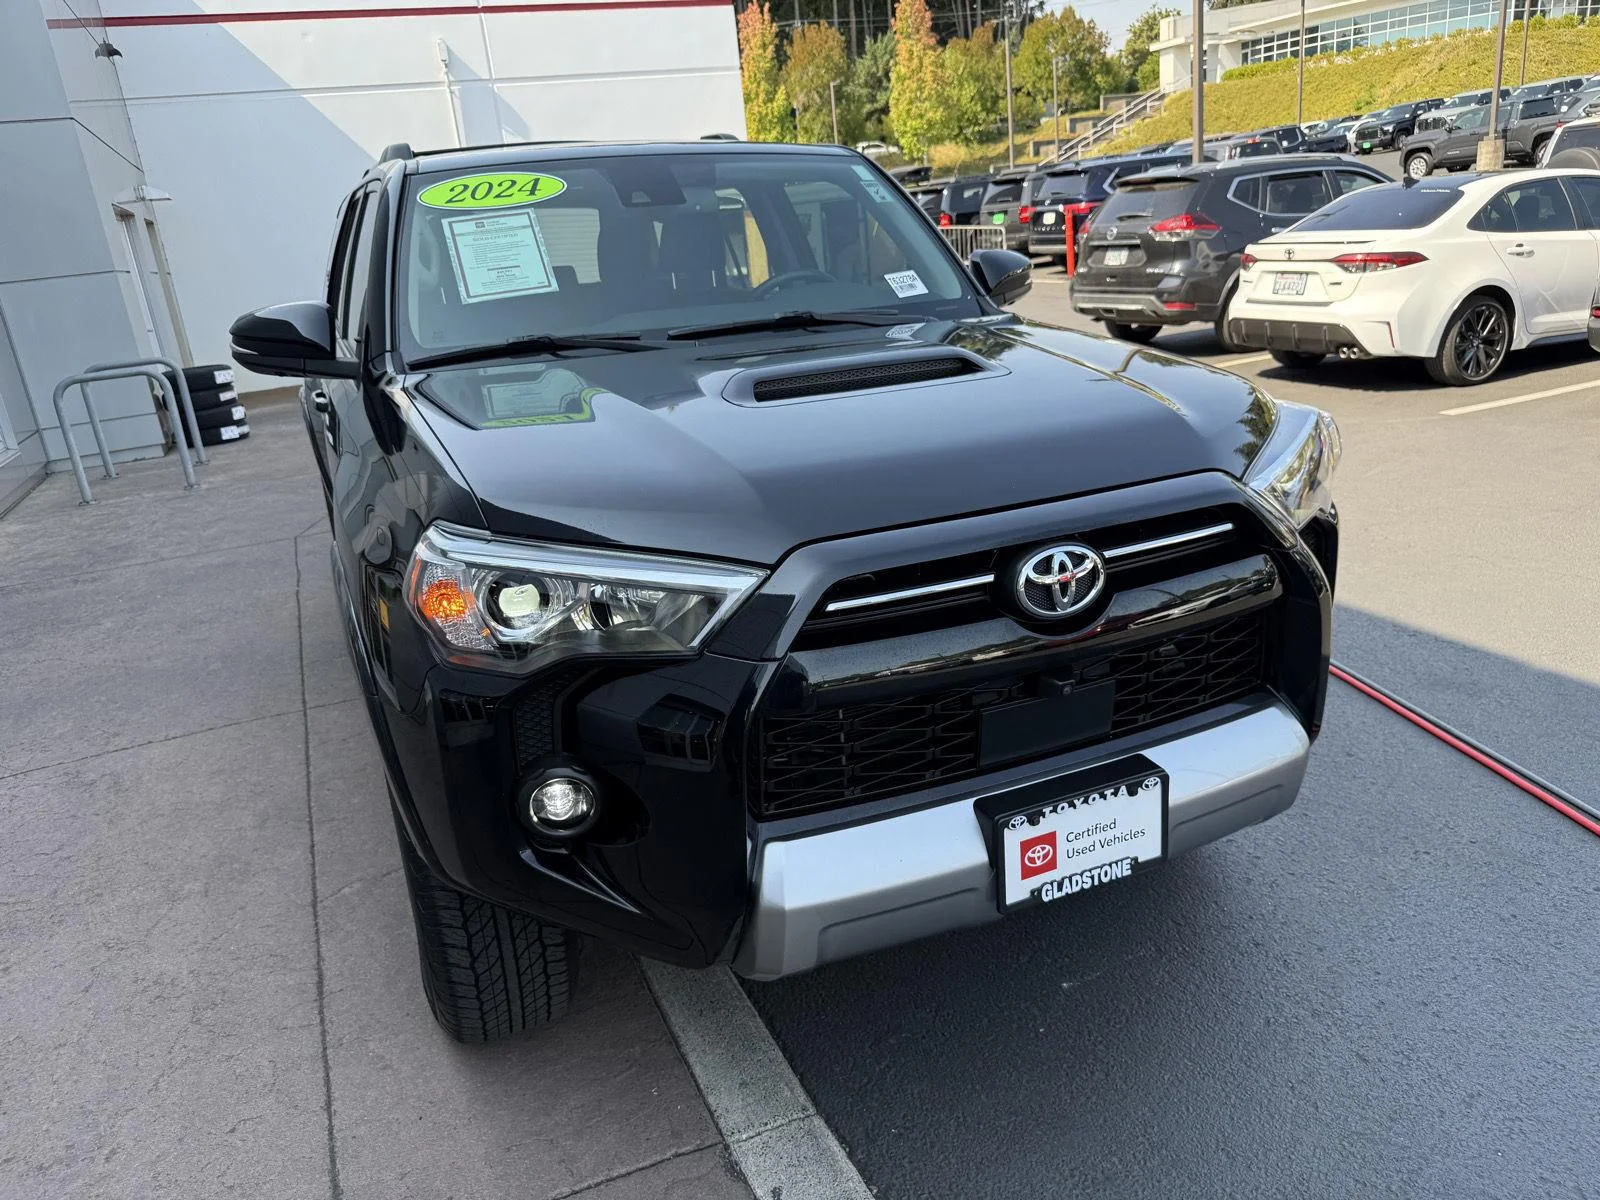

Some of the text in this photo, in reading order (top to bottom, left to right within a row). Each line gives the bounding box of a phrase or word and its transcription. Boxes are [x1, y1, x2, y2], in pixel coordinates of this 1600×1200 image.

[444, 177, 542, 204] 2024
[1042, 785, 1129, 819] TOYOTA
[1065, 818, 1117, 843] Certified
[1066, 828, 1146, 859] Used Vehicles
[1041, 858, 1133, 903] GLADSTONE
